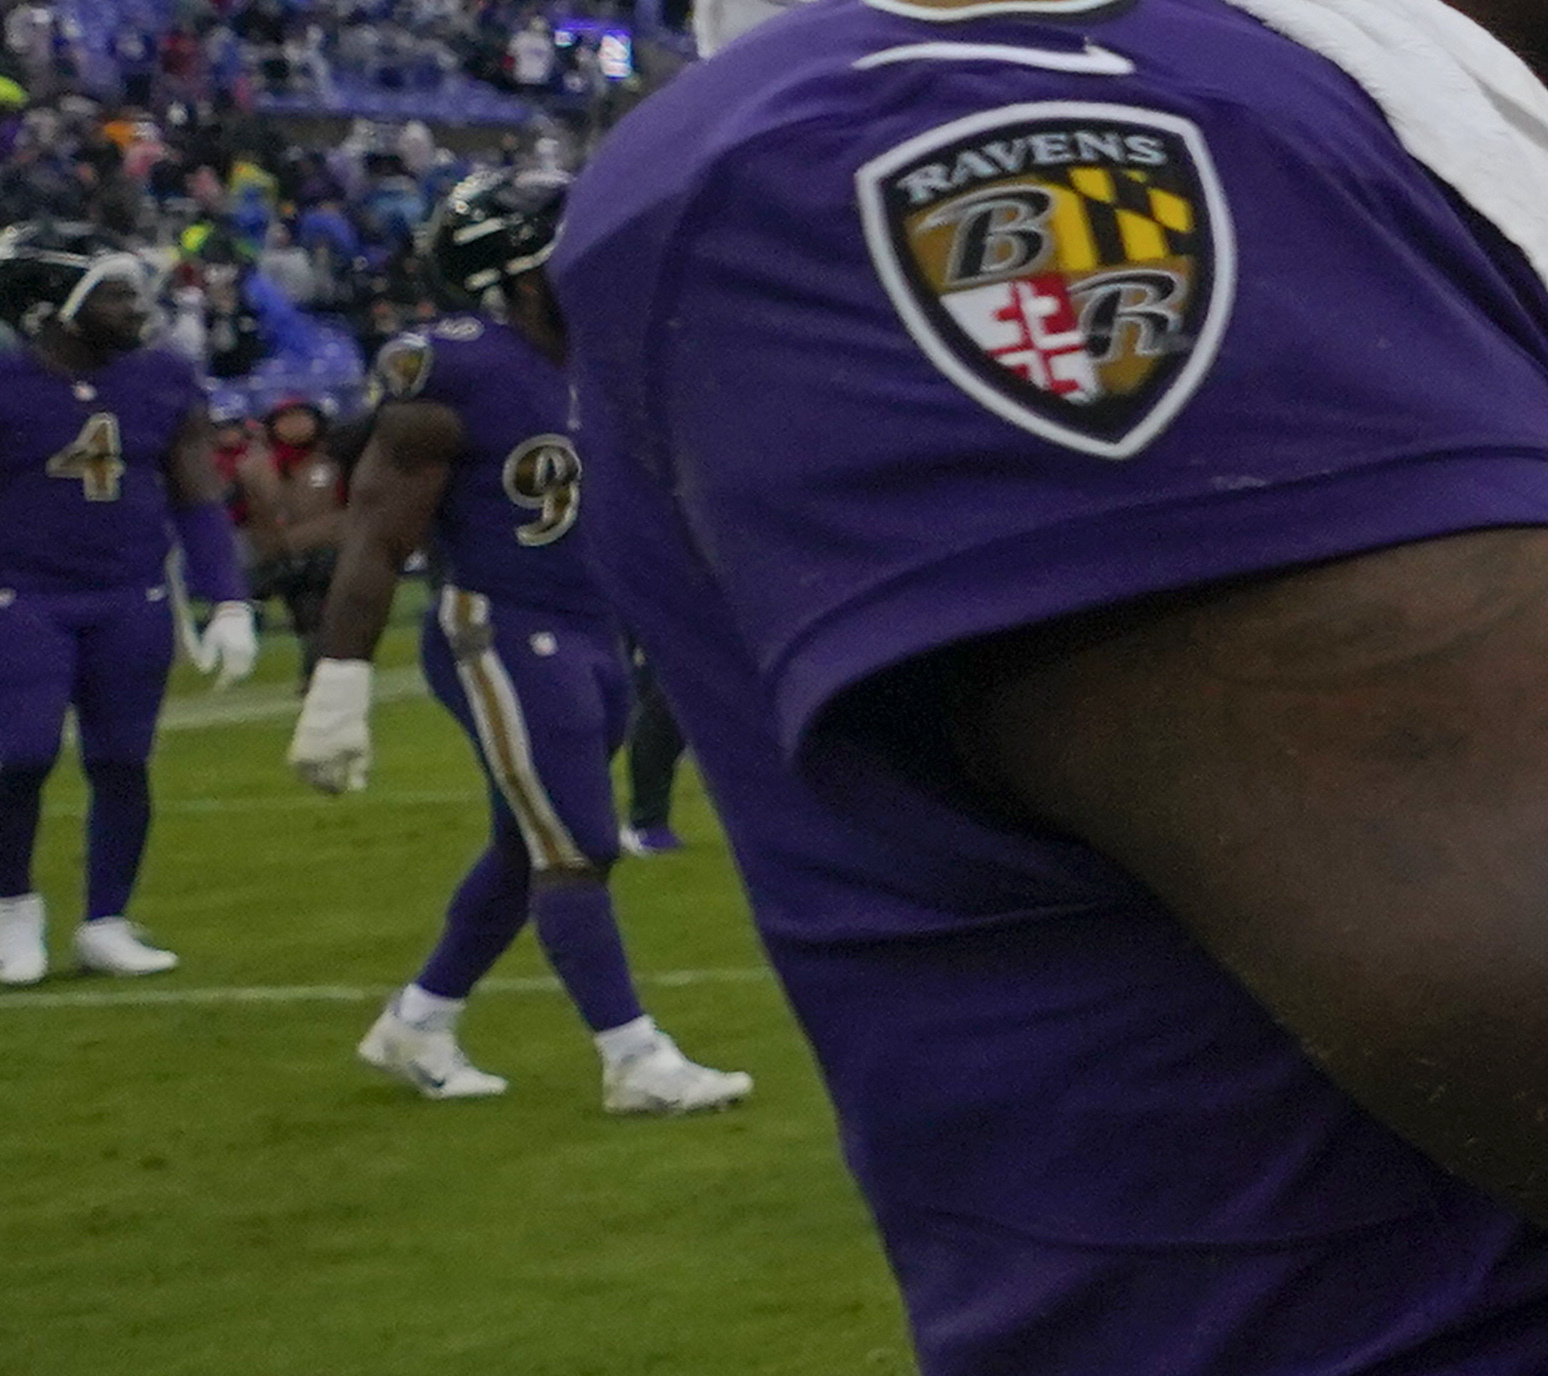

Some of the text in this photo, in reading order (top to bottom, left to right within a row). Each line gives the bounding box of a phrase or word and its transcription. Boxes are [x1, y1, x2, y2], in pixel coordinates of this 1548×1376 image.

[896, 129, 1168, 205] RAVENS
[45, 411, 127, 503] 4
[502, 432, 584, 547] 9
